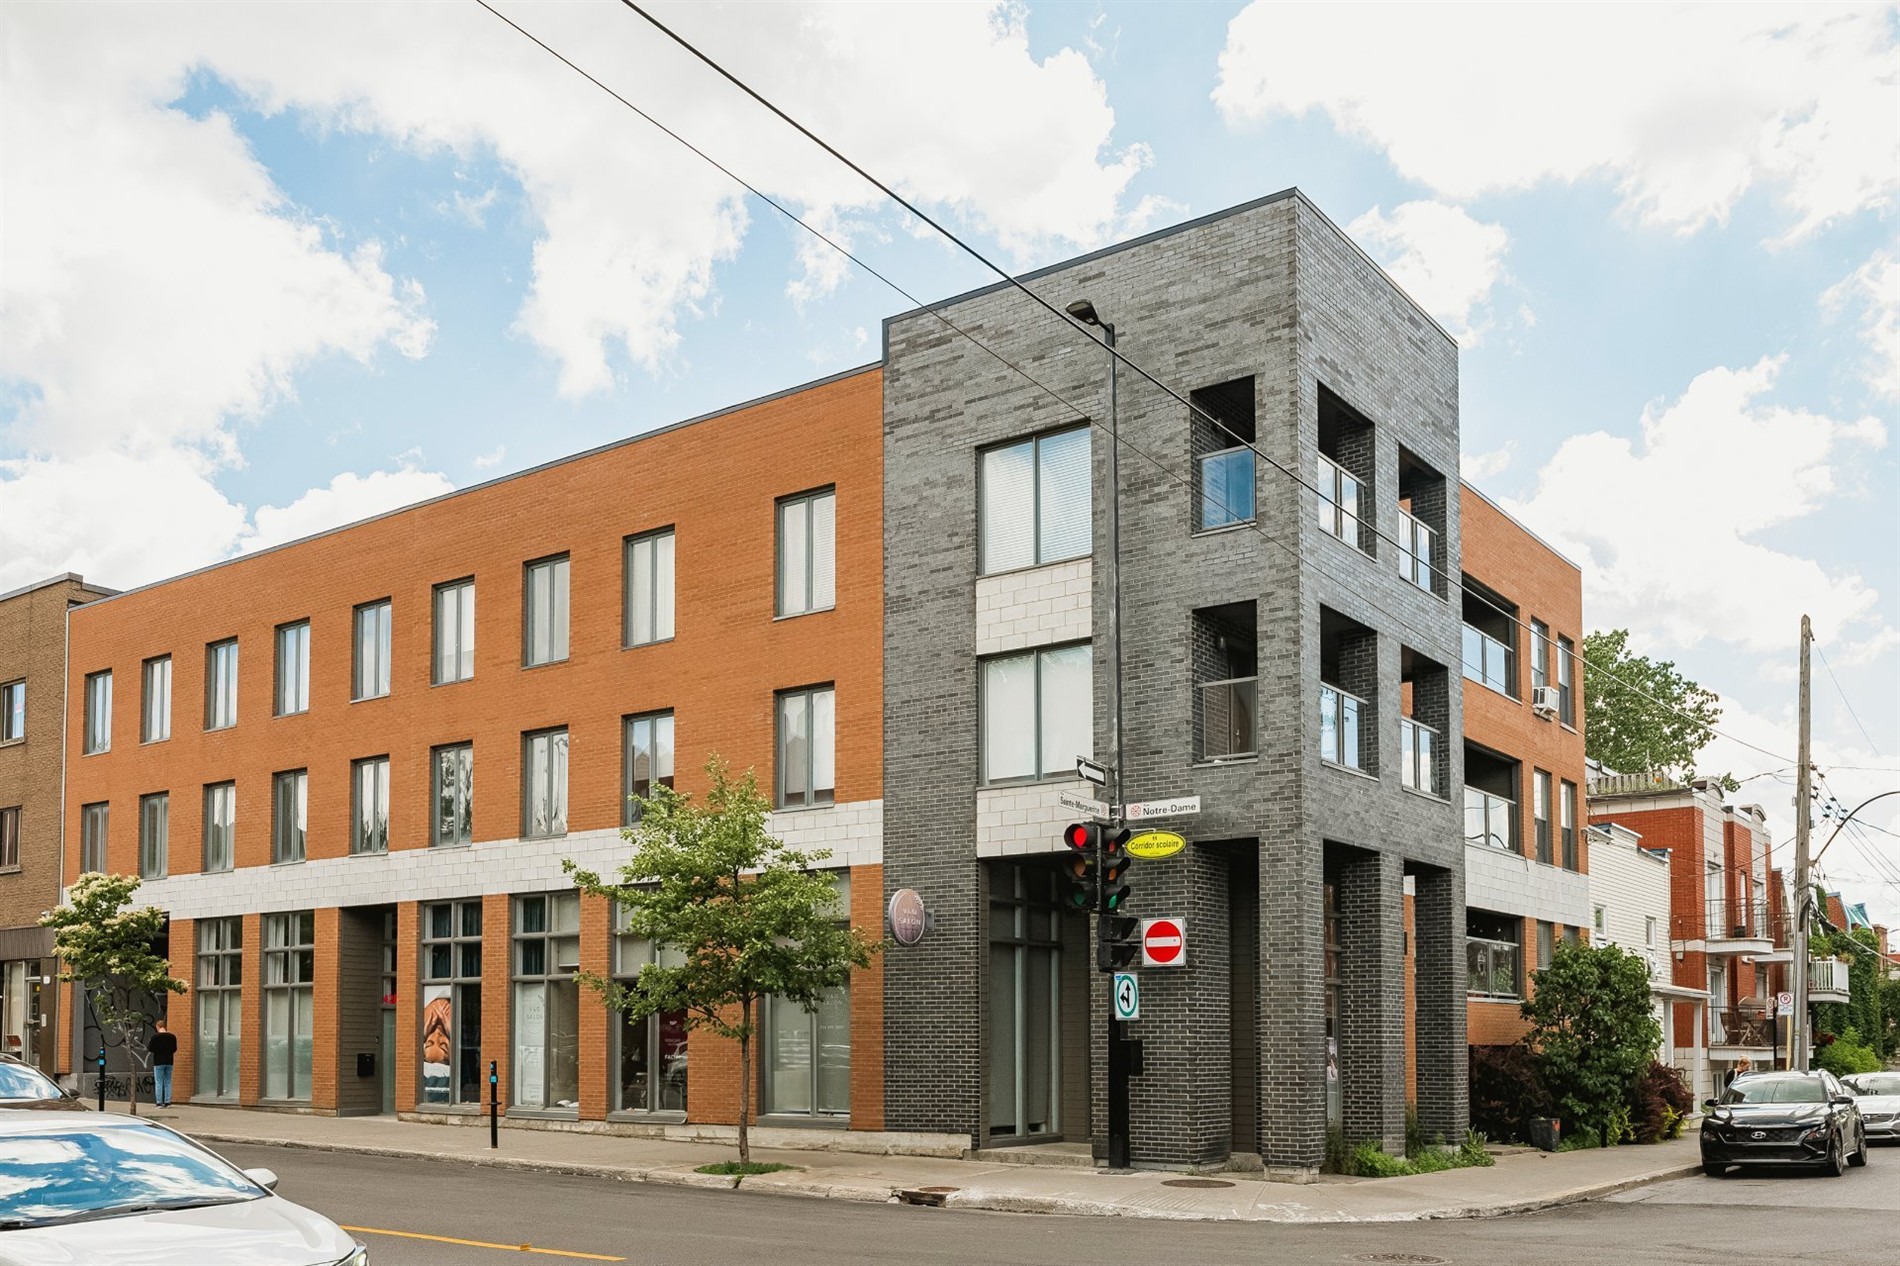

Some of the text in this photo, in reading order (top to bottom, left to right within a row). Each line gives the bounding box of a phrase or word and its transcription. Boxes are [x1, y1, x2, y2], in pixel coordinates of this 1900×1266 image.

[1143, 804, 1196, 815] Notre-Dame
[1130, 840, 1179, 850] Corridor scolaire
